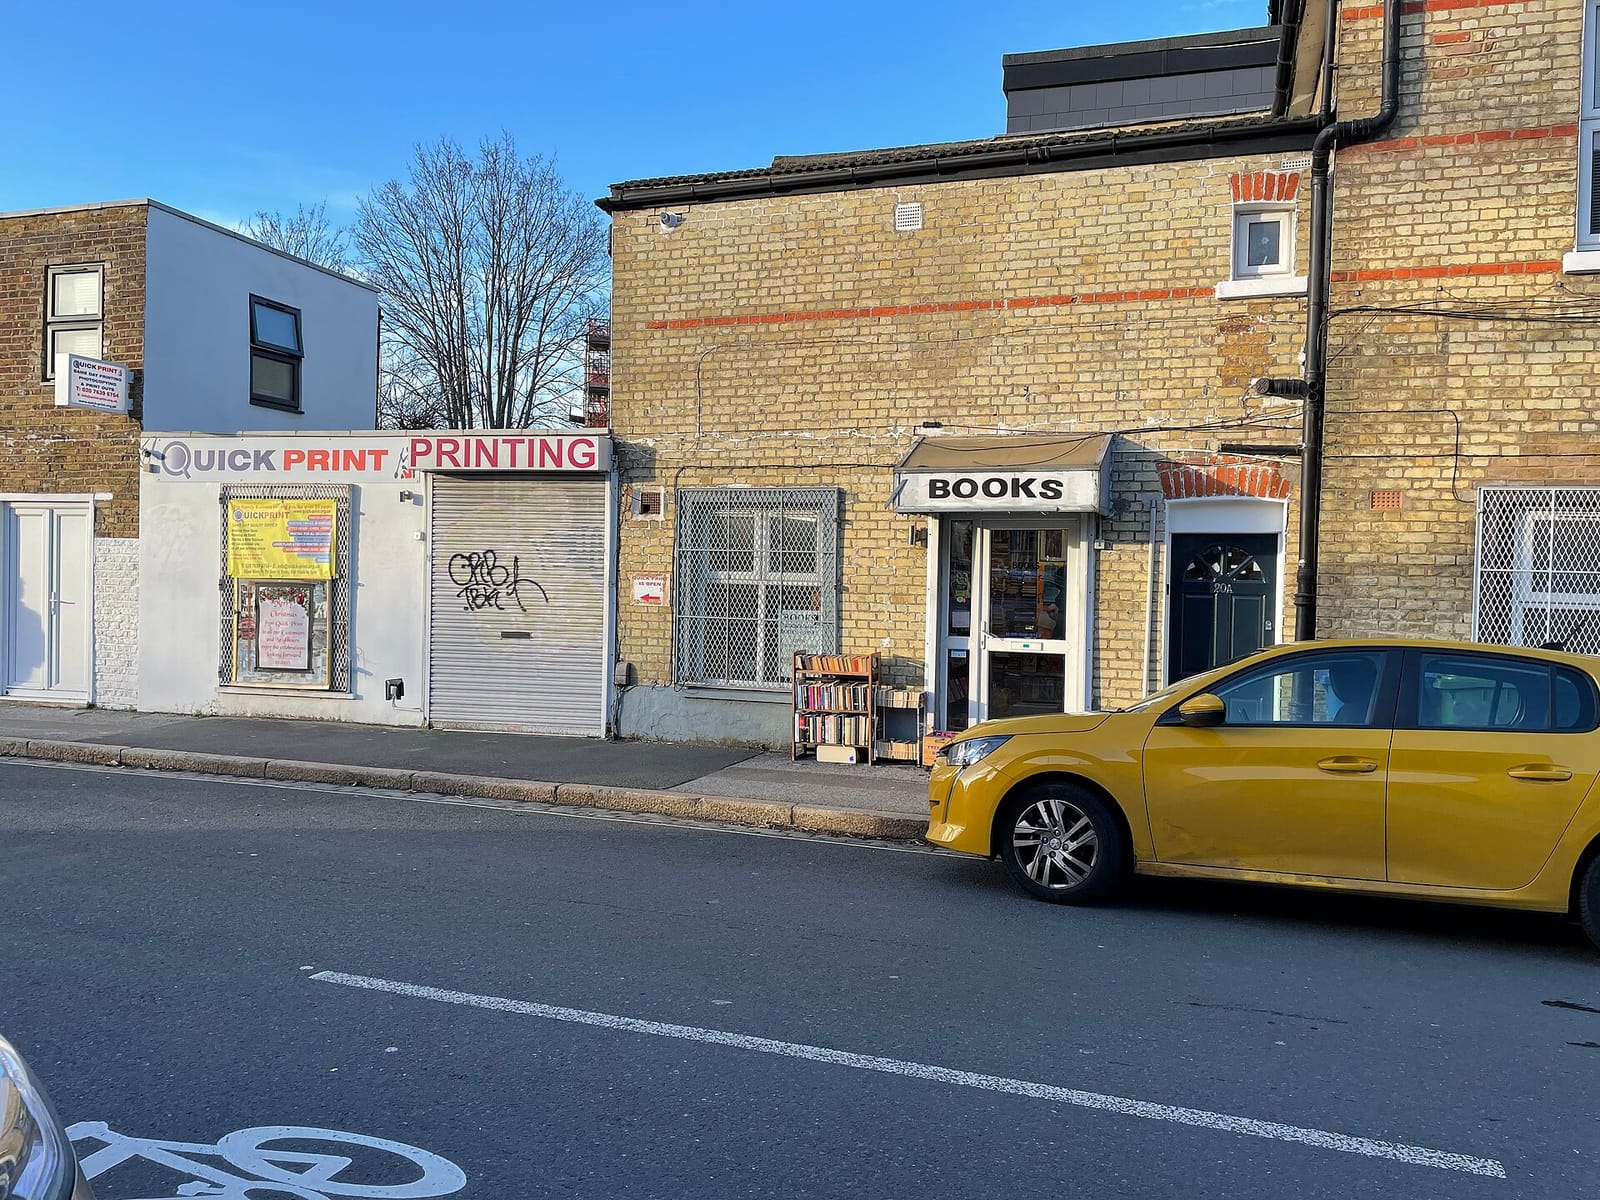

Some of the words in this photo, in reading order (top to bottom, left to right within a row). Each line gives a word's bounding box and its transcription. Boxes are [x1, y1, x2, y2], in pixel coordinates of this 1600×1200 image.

[73, 360, 96, 370] QUICK
[98, 366, 118, 374] PRINT
[99, 374, 122, 382] PRINTING
[162, 440, 276, 480] QUICK
[283, 450, 388, 472] PRINT
[410, 438, 596, 468] PRINTING
[928, 478, 1064, 500] BOOKS
[1012, 562, 1040, 570] BOOKS
[1213, 583, 1233, 593] 20A
